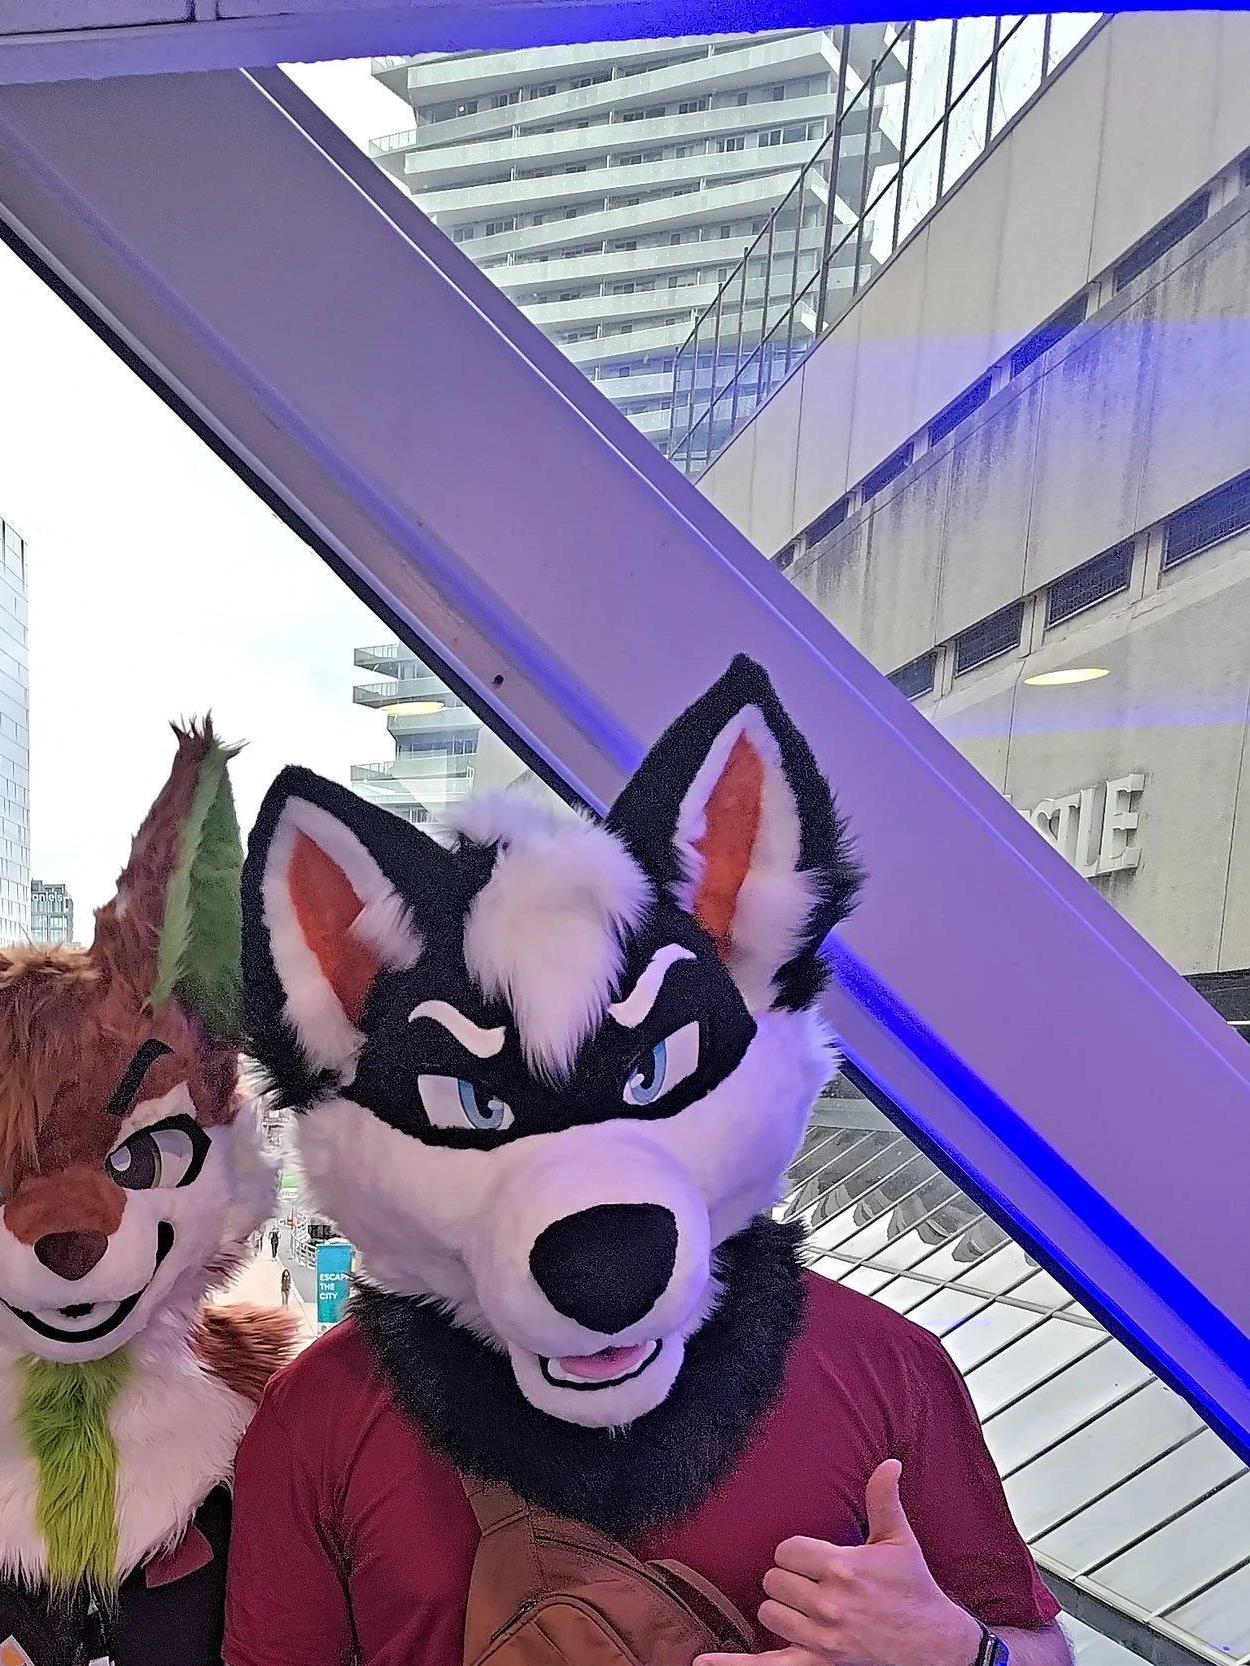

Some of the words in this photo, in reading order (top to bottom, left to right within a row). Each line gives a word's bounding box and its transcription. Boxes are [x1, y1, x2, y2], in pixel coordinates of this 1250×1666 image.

[319, 1273, 349, 1281] ESCAP
[319, 1283, 335, 1291] THE
[319, 1292, 338, 1300] CITY
